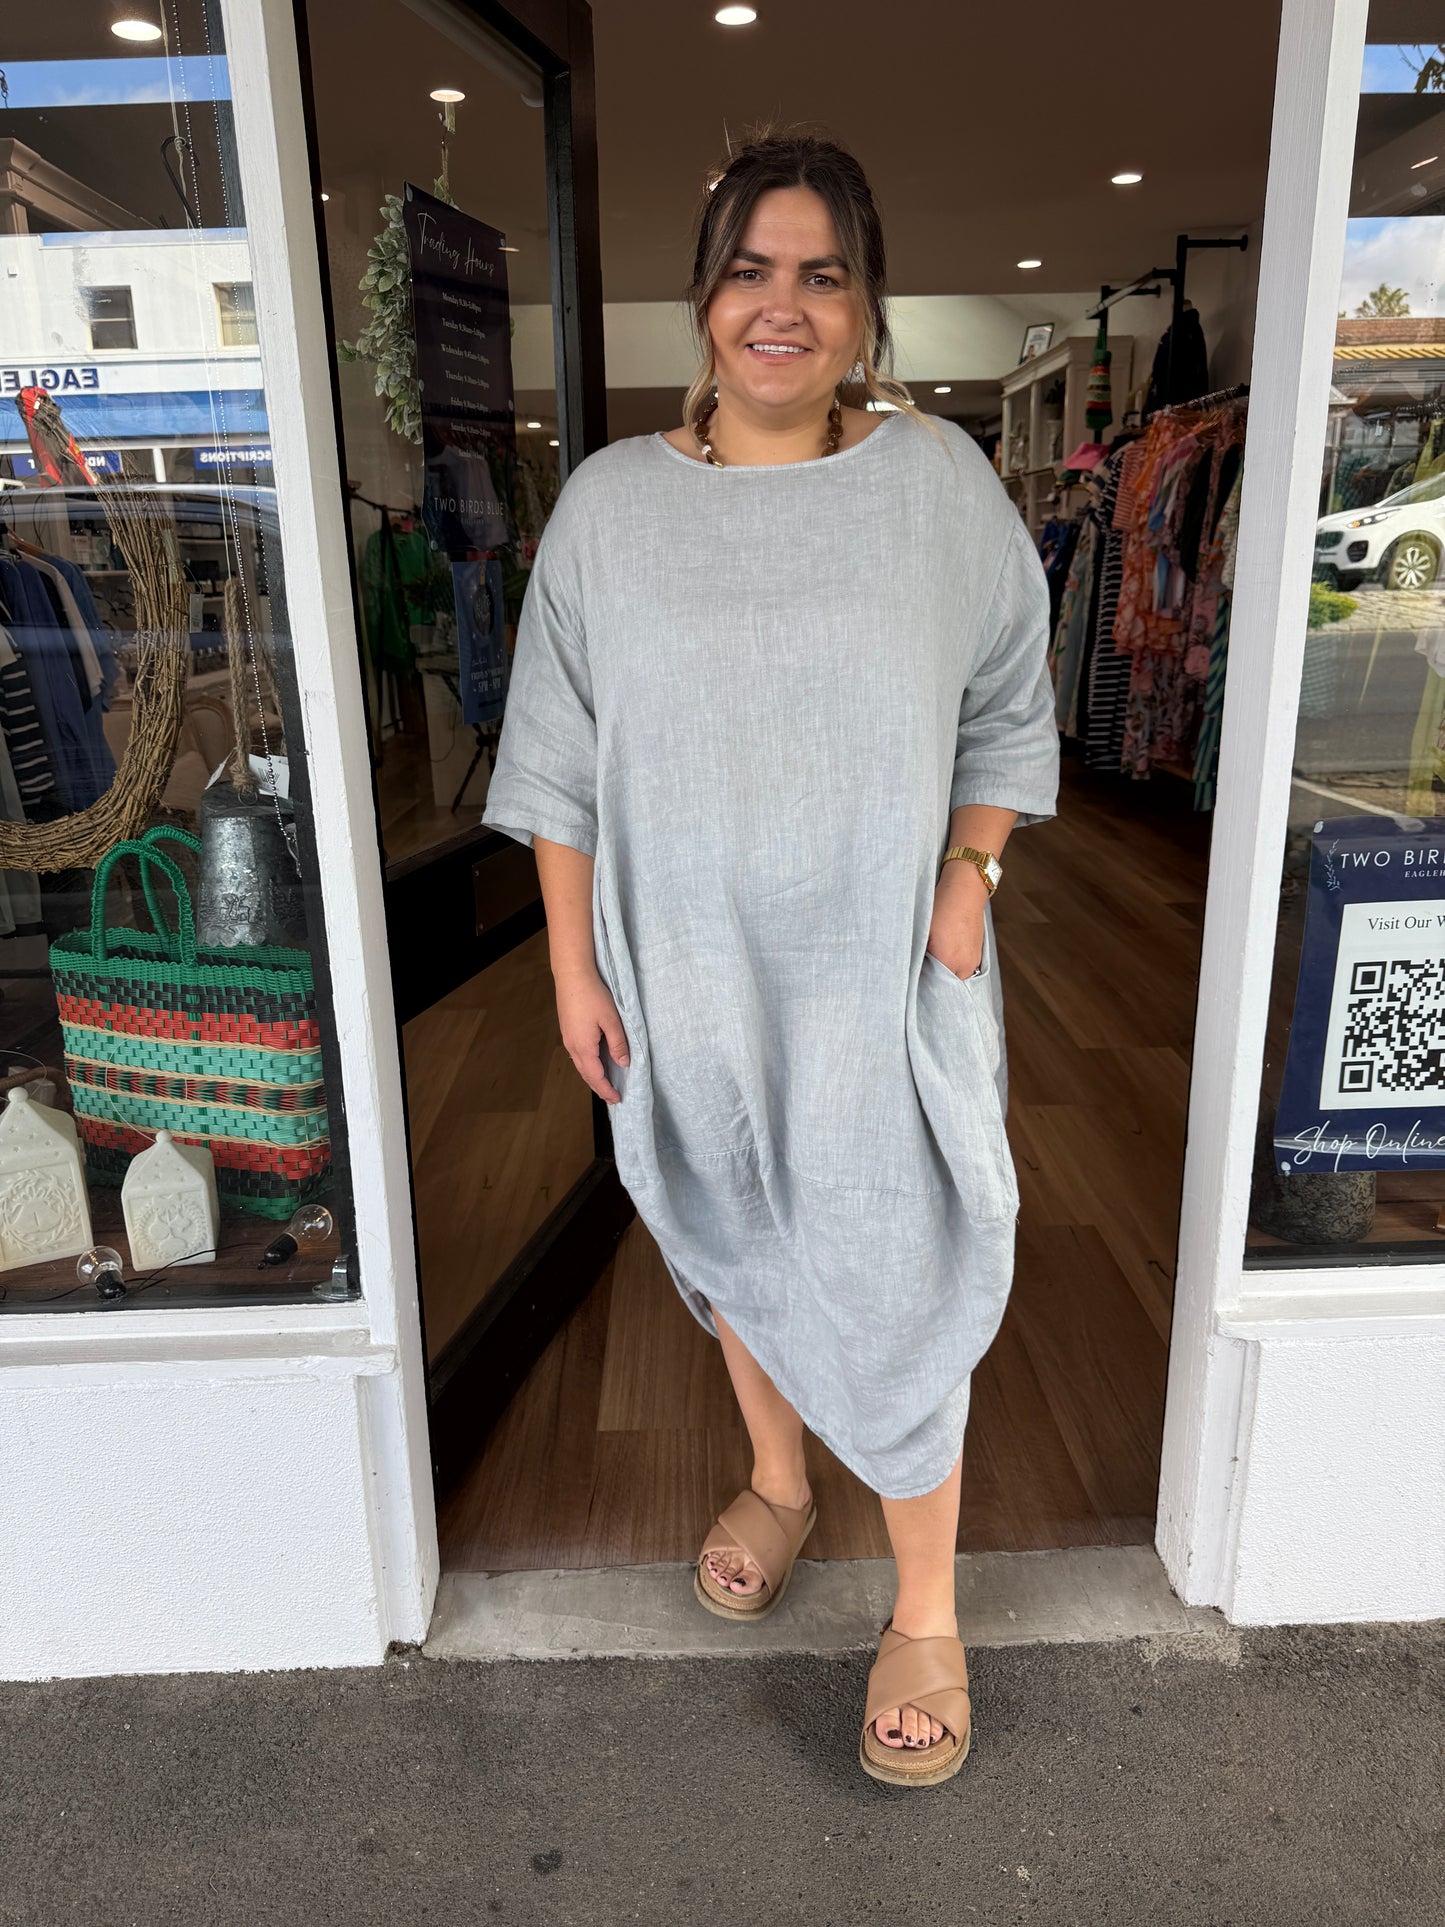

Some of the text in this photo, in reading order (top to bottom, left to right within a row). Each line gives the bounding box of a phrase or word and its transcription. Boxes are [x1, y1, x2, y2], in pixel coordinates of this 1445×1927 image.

[418, 211, 496, 278] Trading Hours
[434, 497, 504, 516] TWO BIRDS BLUE
[1340, 849, 1445, 869] TWO BIR
[1368, 917, 1400, 930] Visit
[1404, 916, 1432, 929] Our
[1293, 1119, 1445, 1173] Shop Online
